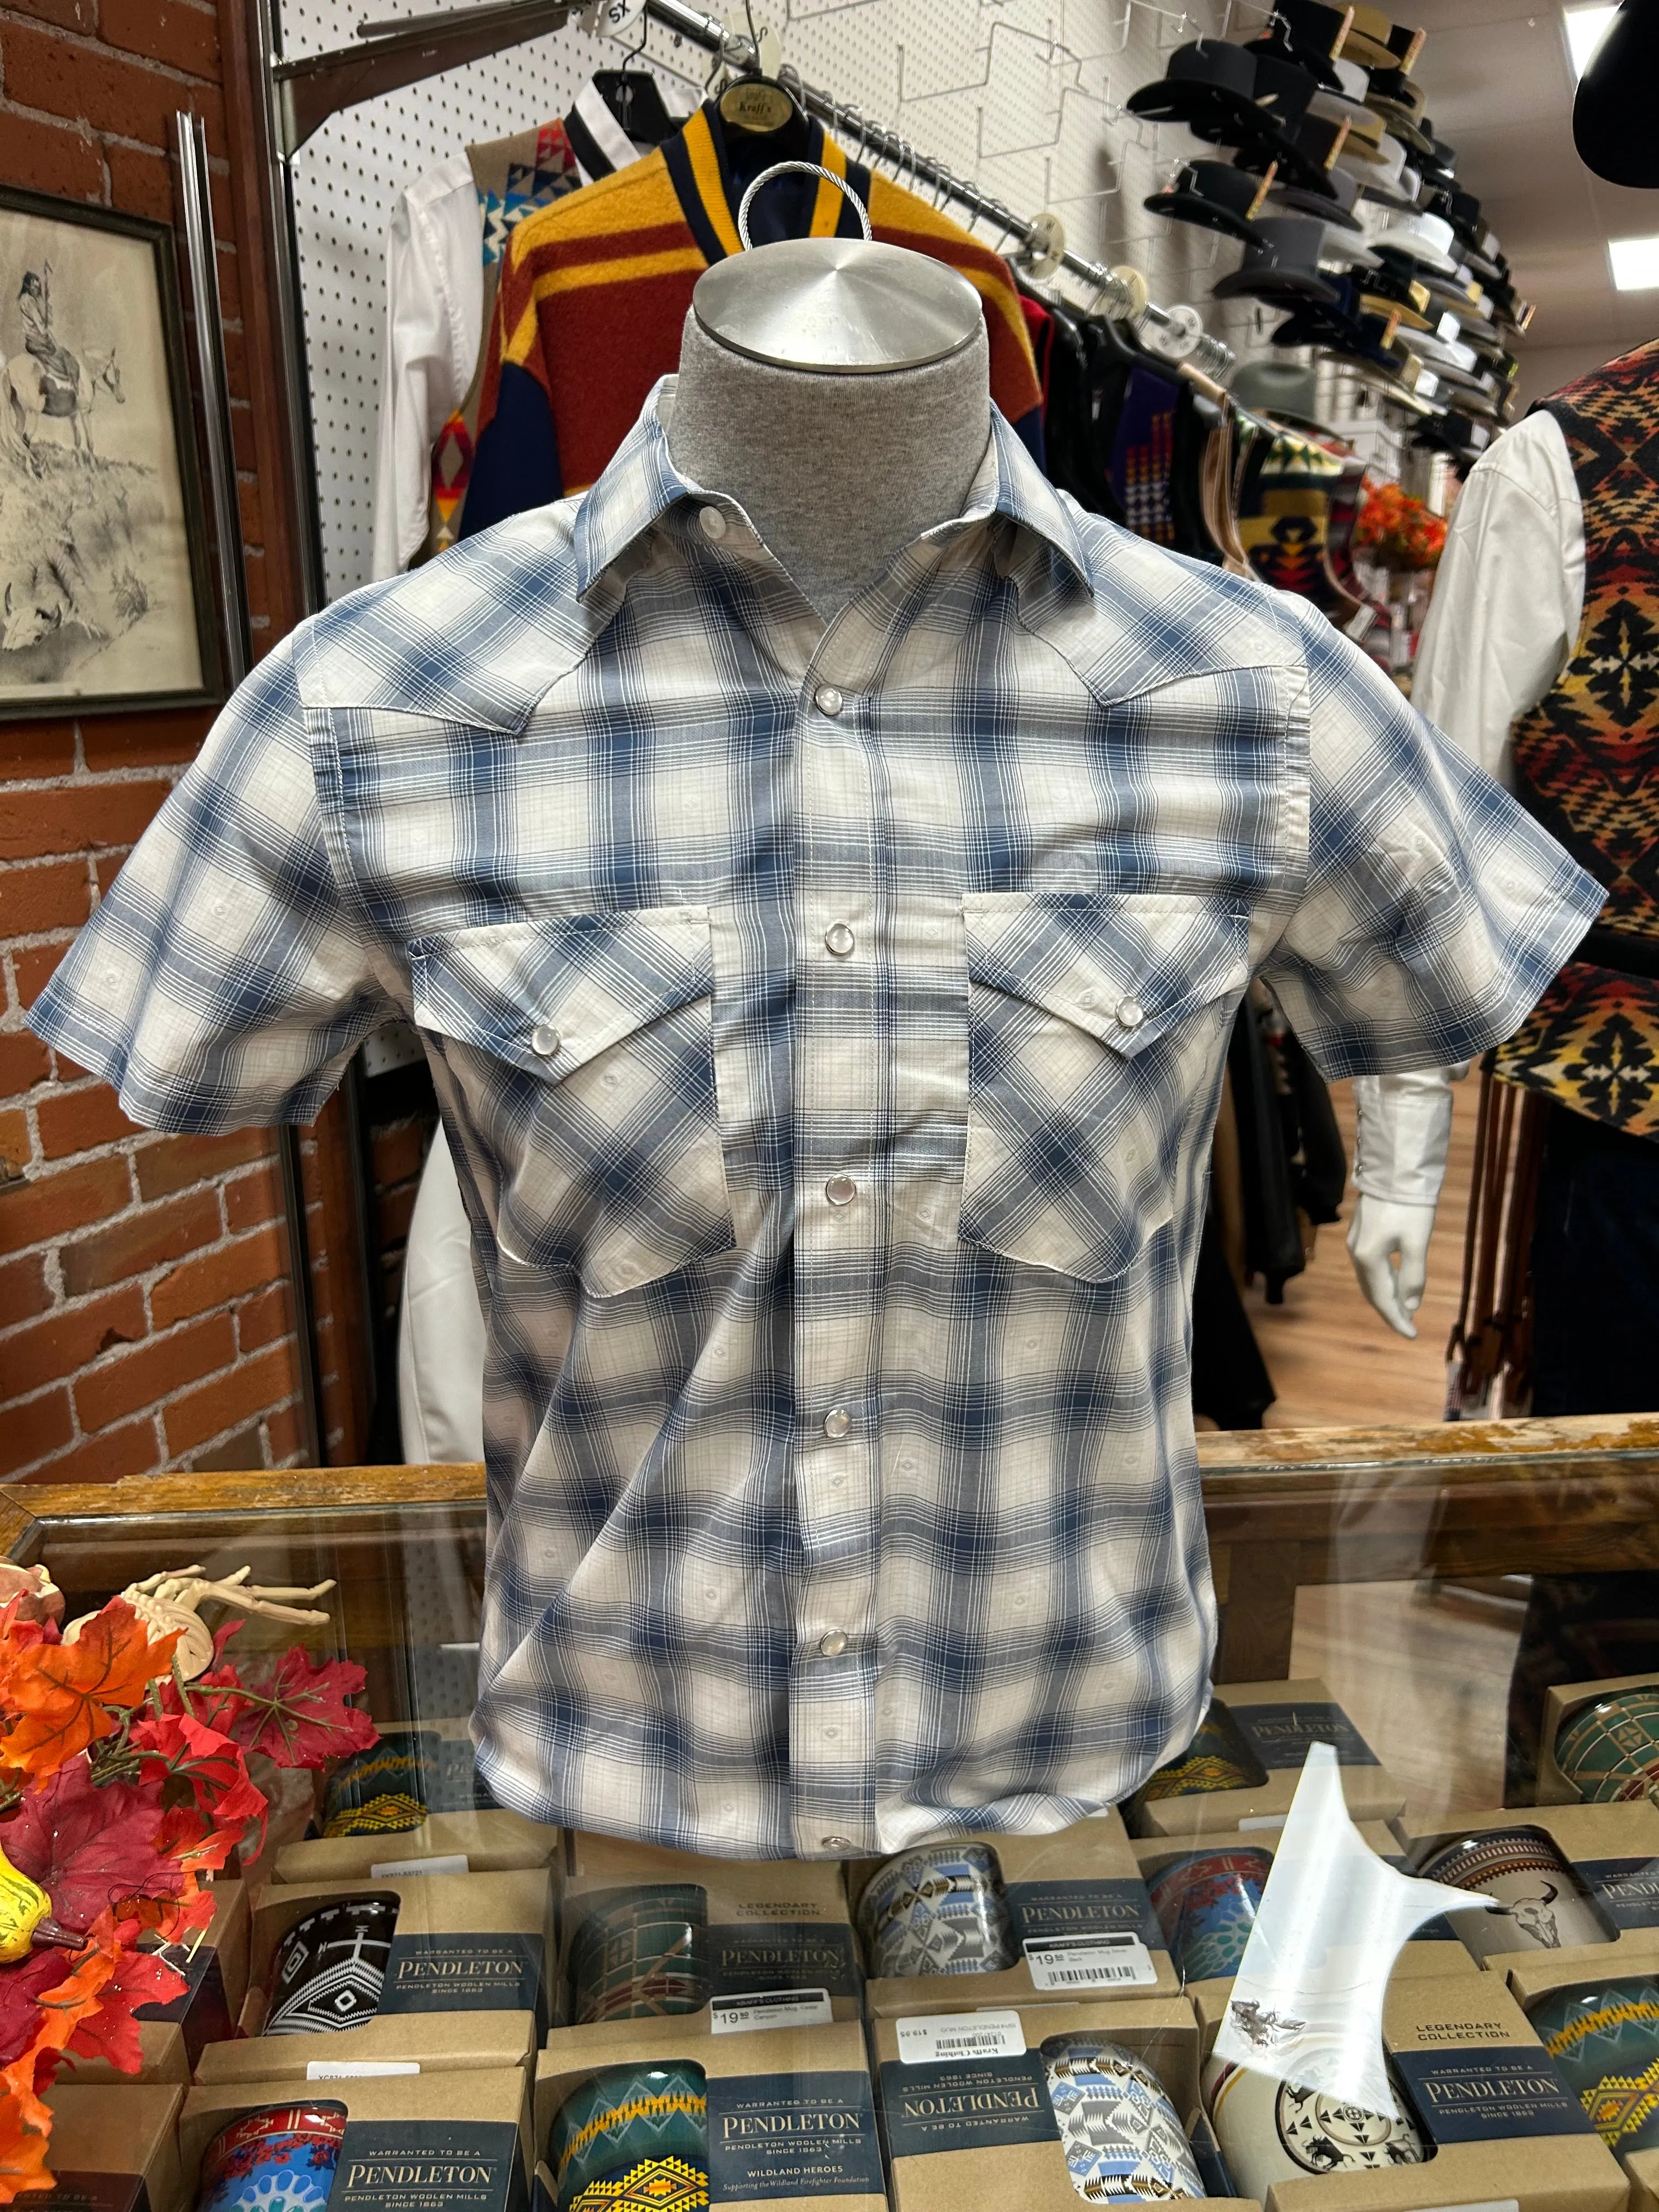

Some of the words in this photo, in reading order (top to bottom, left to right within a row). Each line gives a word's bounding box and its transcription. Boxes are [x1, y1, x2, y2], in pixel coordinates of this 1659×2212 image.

[1022, 1905, 1139, 1923] PENDLETON
[722, 1949, 840, 1966] PENDLETON
[397, 1961, 522, 1979] PENDLETON
[1415, 2023, 1502, 2032] LEGENDARY
[1418, 2031, 1510, 2041] COLLECTION
[935, 2049, 971, 2058] Clothing
[1431, 2067, 1492, 2075] WARRANTED
[934, 2080, 973, 2089] WOOLEN
[976, 2075, 1032, 2085] PENDLETON
[1423, 2078, 1559, 2103] PENDLETON
[737, 2100, 800, 2109] WARRANTED
[904, 2087, 1040, 2117] PENDLETON
[1439, 2107, 1496, 2115] PENDLETON
[723, 2113, 860, 2138] PENDLETON
[966, 2116, 1029, 2127] WARRANTED
[725, 2142, 784, 2151] PENDLETON
[347, 2165, 493, 2188] PENDLETON
[747, 2168, 800, 2177] WILDLAND
[804, 2165, 843, 2174] HEROES
[723, 2181, 758, 2192] Supporting
[769, 2179, 798, 2187] Wildland
[800, 2177, 832, 2186] Firefighter
